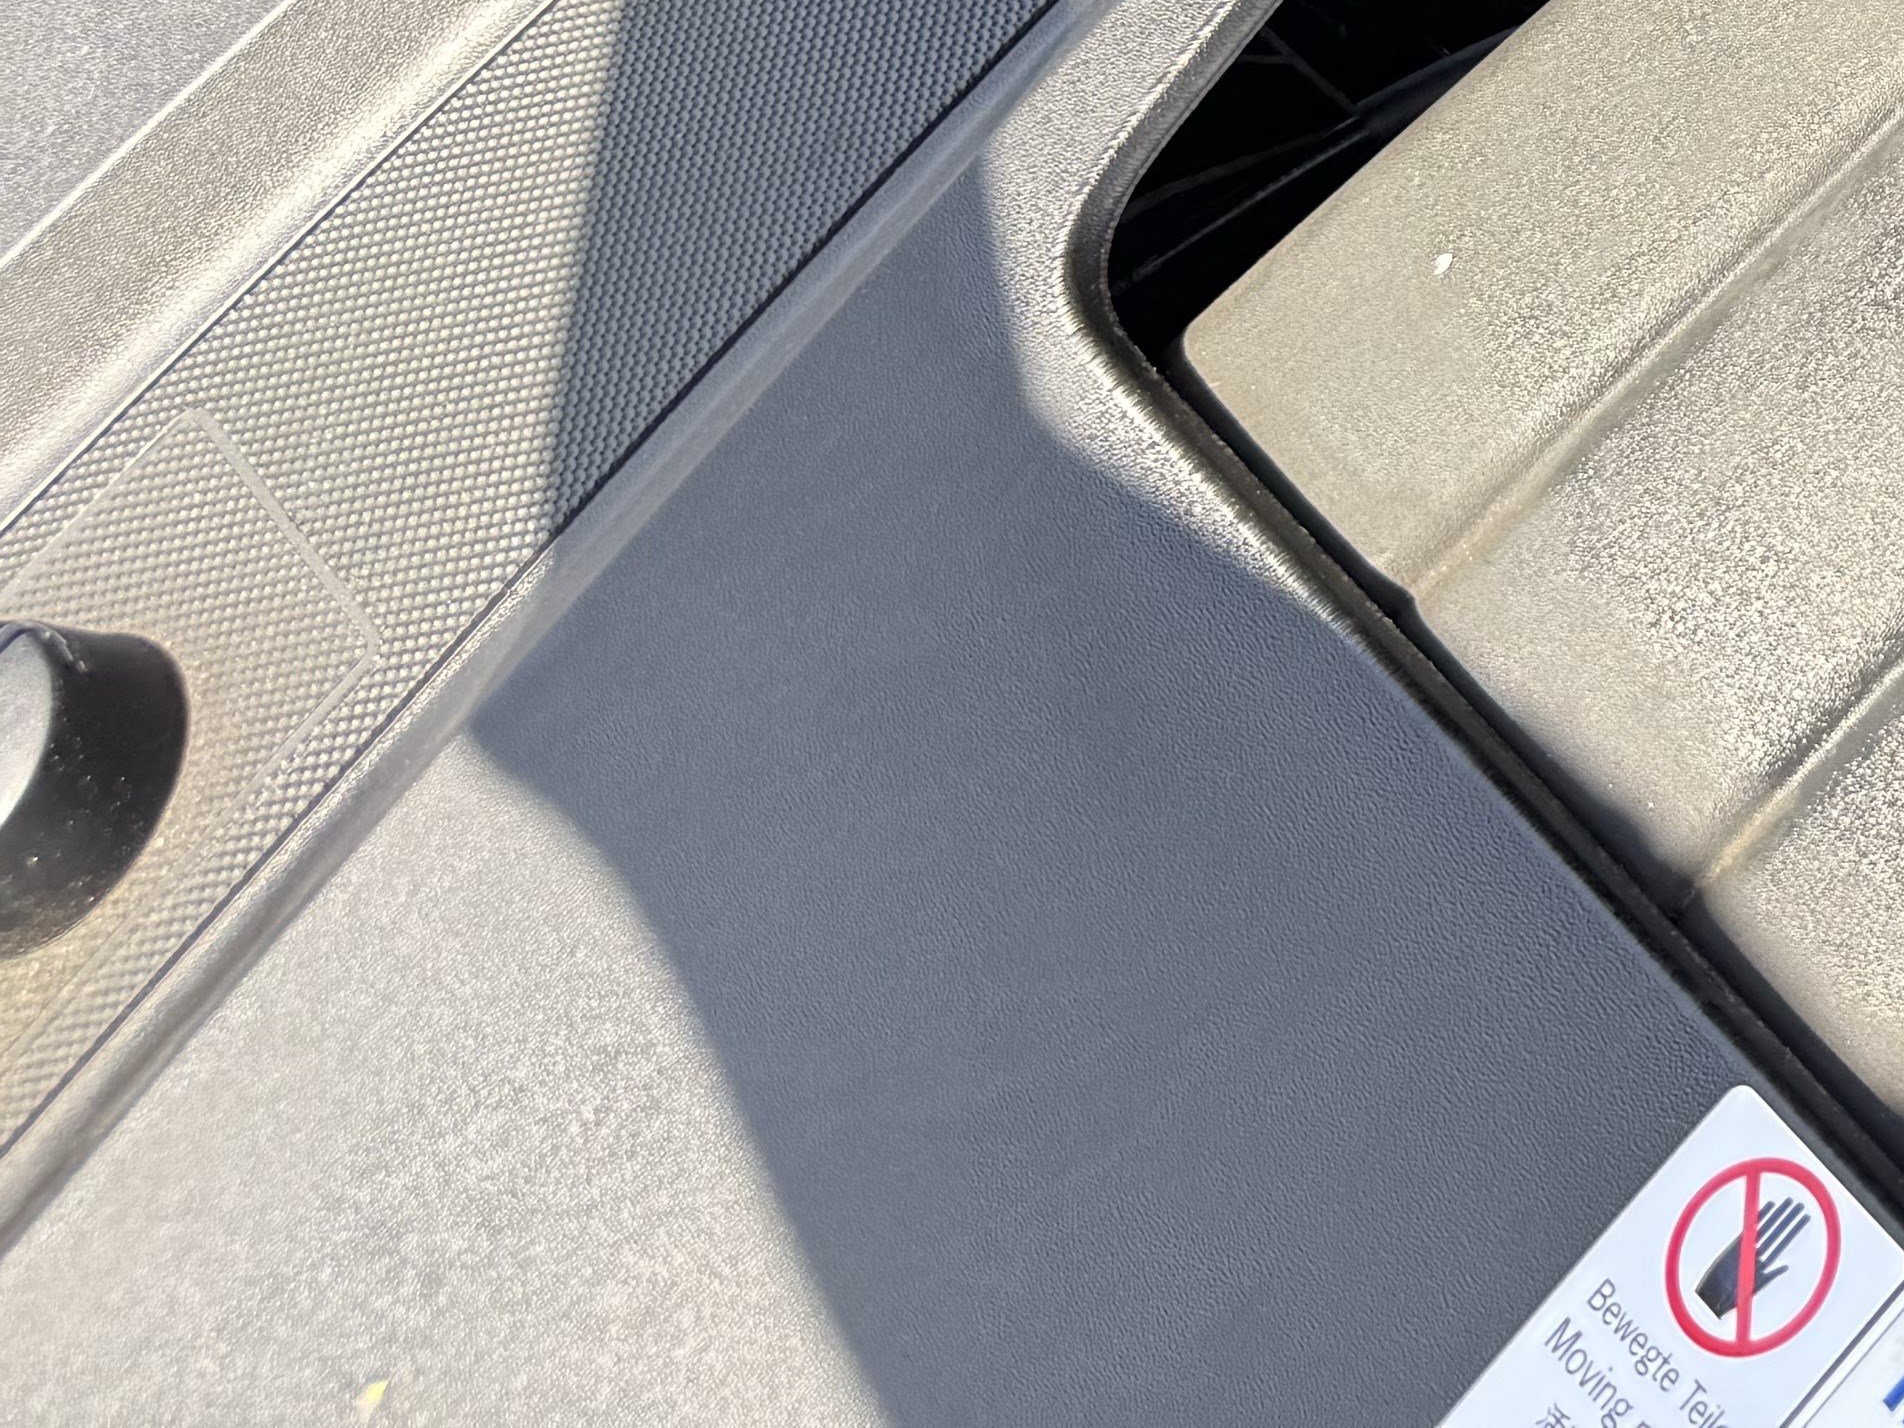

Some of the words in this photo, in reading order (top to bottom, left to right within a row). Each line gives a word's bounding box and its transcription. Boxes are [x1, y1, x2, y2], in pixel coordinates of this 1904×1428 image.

[1544, 1316, 1634, 1428] Moving
[1586, 1278, 1680, 1393] Bewegte
[1679, 1378, 1728, 1428] Teil
